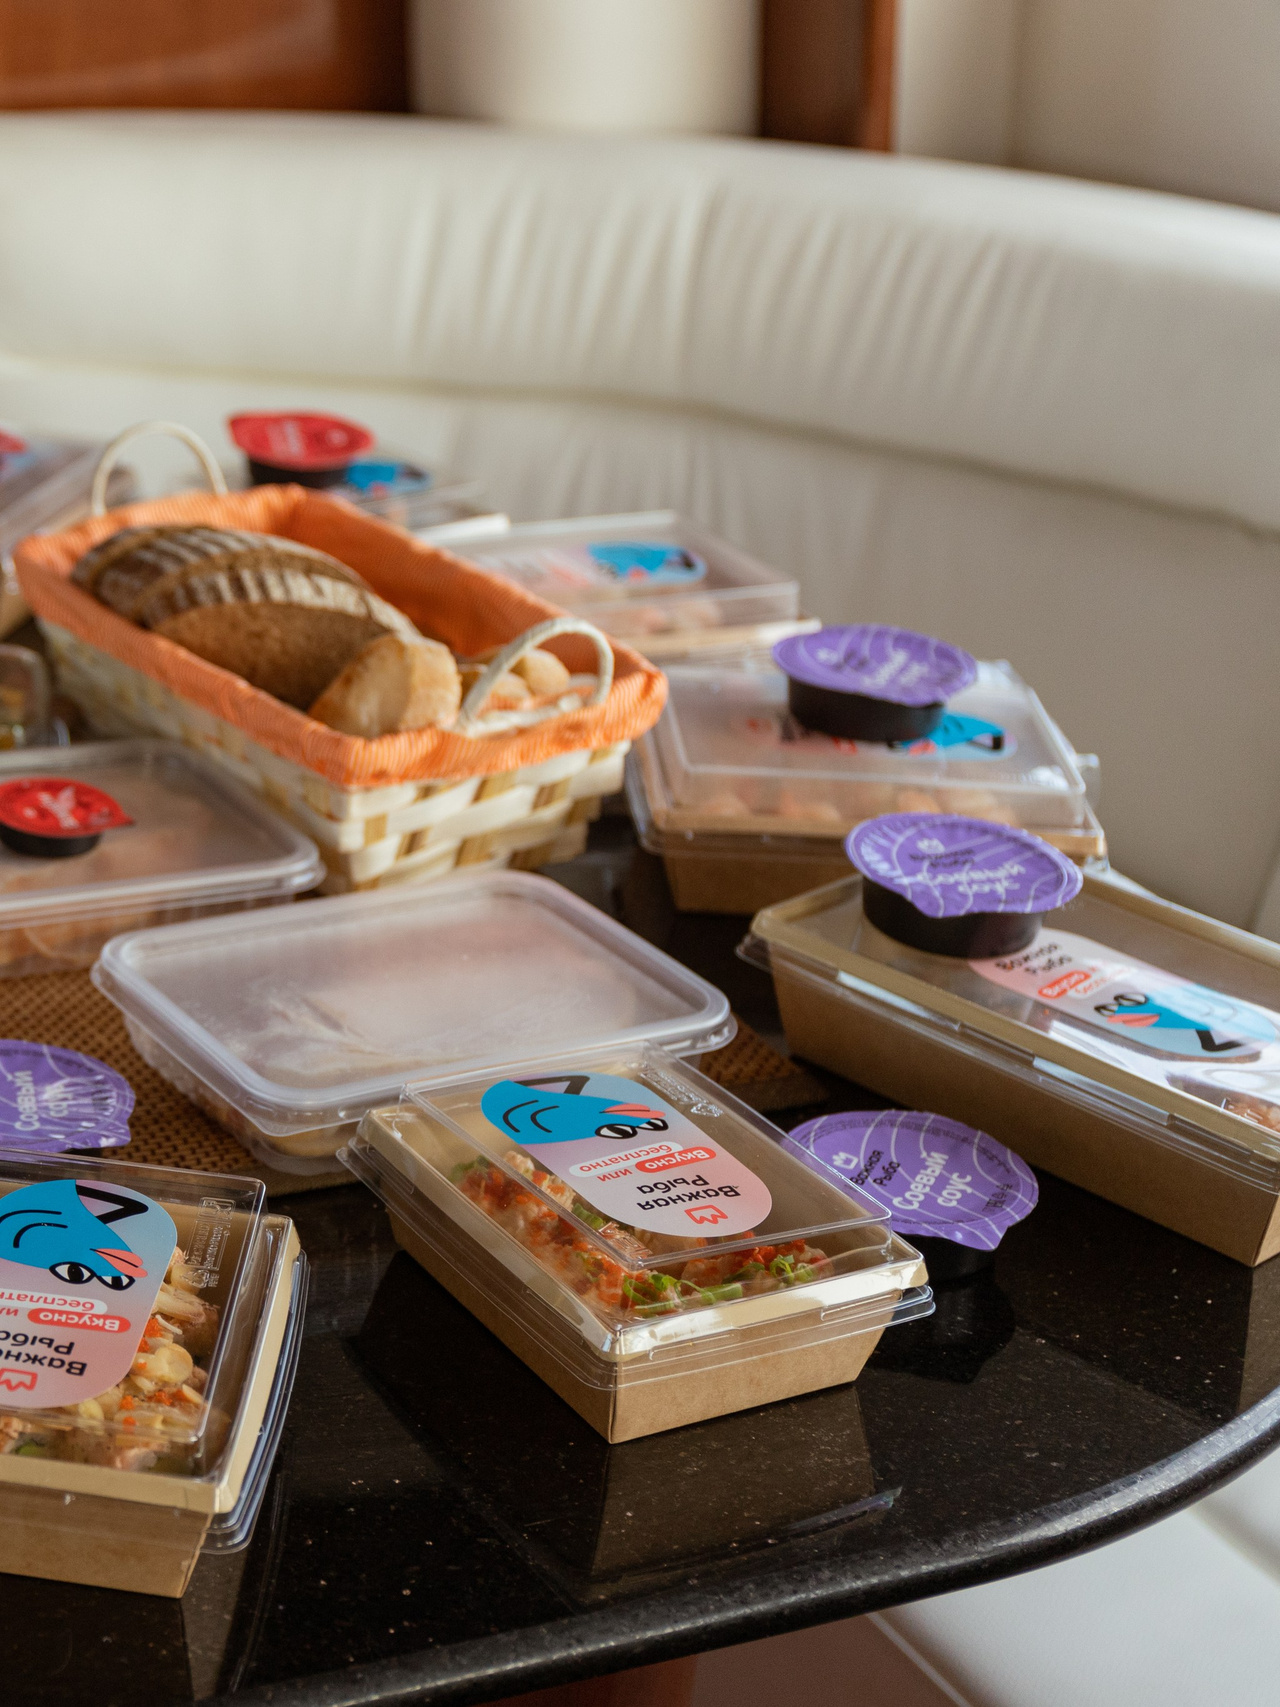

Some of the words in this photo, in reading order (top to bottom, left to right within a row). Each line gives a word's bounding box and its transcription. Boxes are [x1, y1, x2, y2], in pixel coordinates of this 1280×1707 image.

[6, 1070, 41, 1132] Соевый
[579, 1144, 673, 1173] бесплатно
[645, 1149, 710, 1170] Вкусно
[849, 1150, 884, 1186] Важная
[597, 1168, 632, 1182] или
[636, 1174, 710, 1195] Рыба
[872, 1161, 901, 1187] Рыба
[892, 1151, 949, 1210] Соевый
[637, 1184, 742, 1211] Важная
[937, 1172, 972, 1207] соус
[39, 1311, 121, 1331] Вкусно
